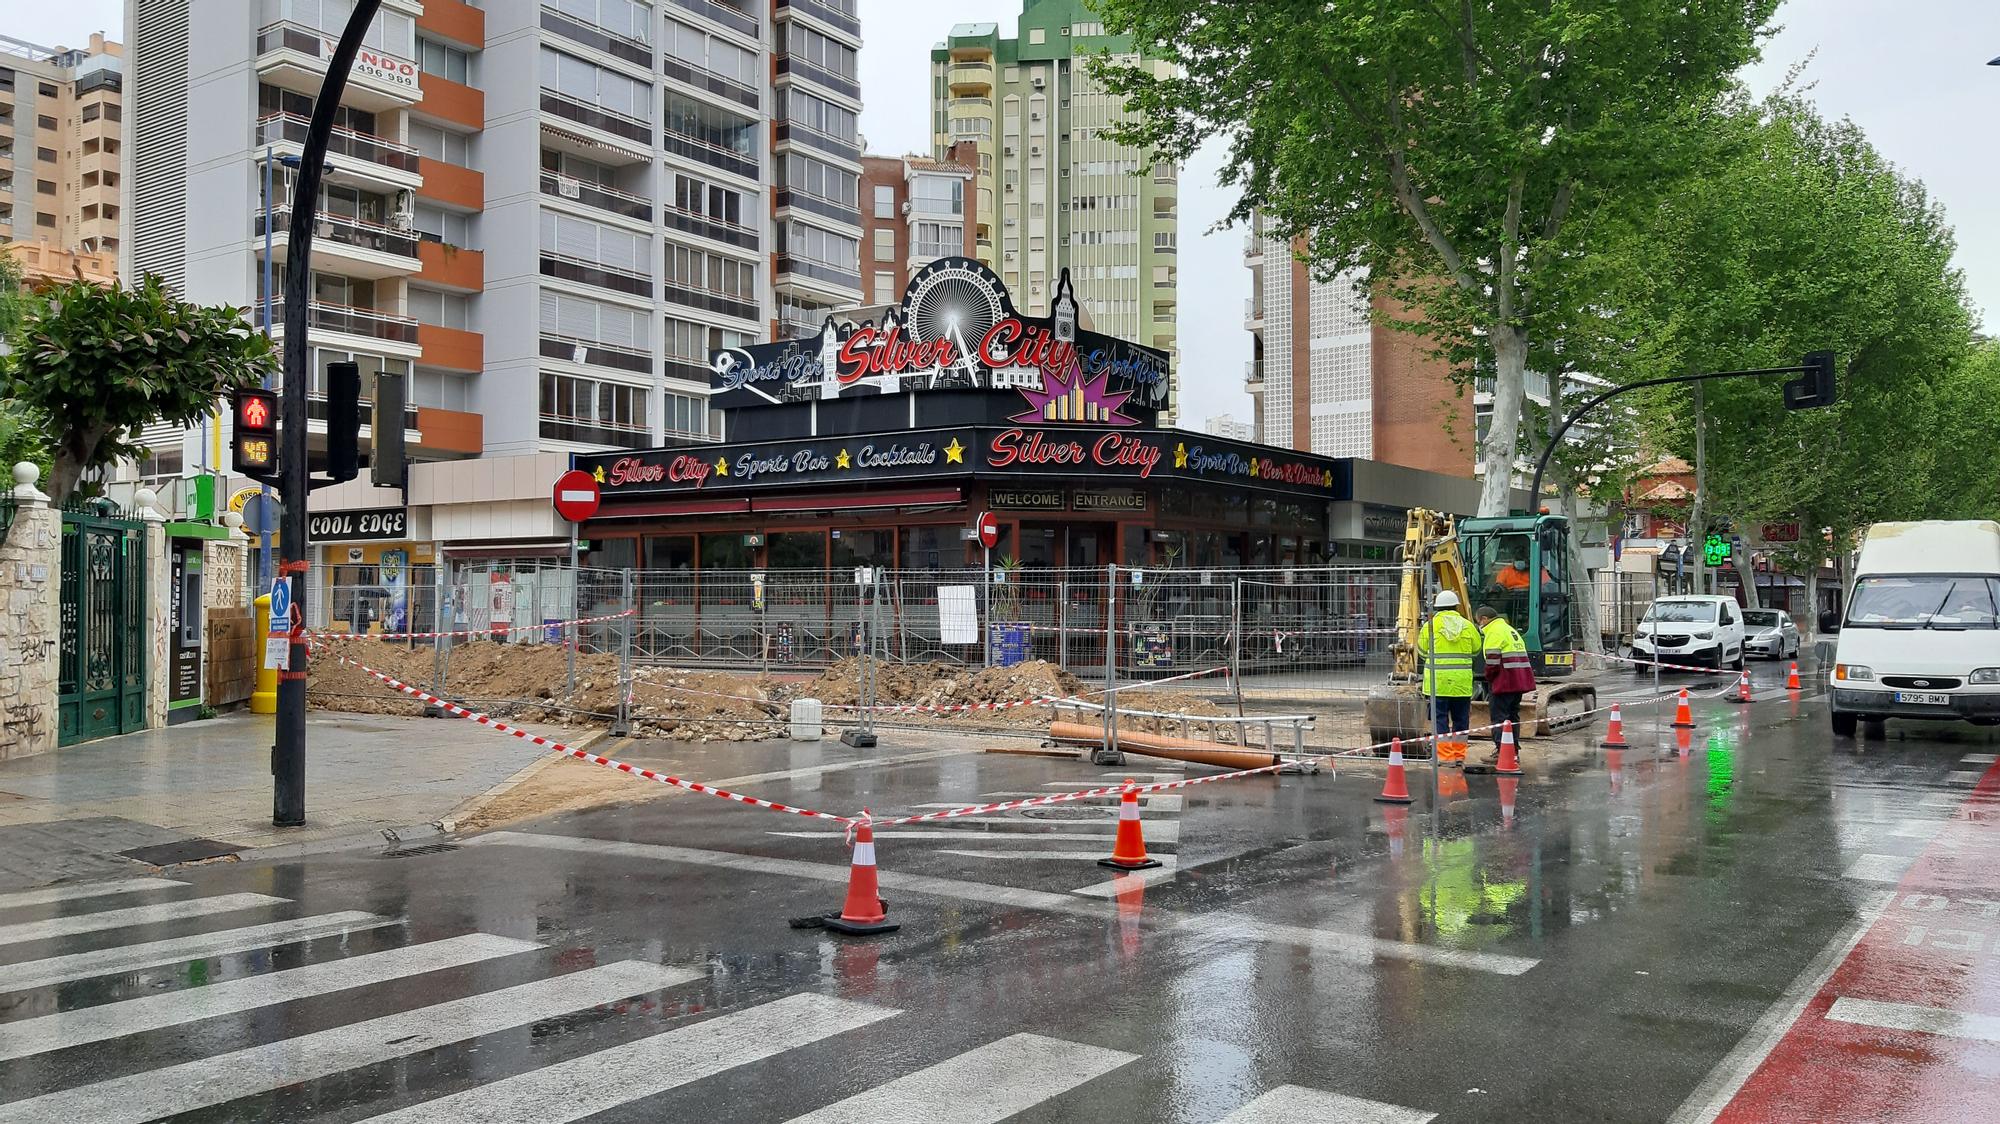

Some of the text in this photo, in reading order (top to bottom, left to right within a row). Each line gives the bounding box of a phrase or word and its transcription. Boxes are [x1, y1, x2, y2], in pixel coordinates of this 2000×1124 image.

[324, 39, 414, 76] VNDO
[358, 64, 412, 86] 496 989
[836, 318, 1077, 384] Silver City
[723, 354, 824, 389] Sports Bar
[735, 449, 829, 480] Sports Bar
[857, 443, 936, 468] Cocktails
[987, 428, 1161, 478] Silver City
[1190, 445, 1251, 475] Sports Bar
[610, 455, 710, 488] Silver City
[1260, 456, 1285, 481] Beer
[1285, 464, 1295, 484] &
[994, 493, 1060, 506] WELCOME
[1075, 495, 1144, 506] ENTRANCE
[310, 513, 404, 535] COOL EDGE
[1901, 693, 1946, 704] 5795 BMX
